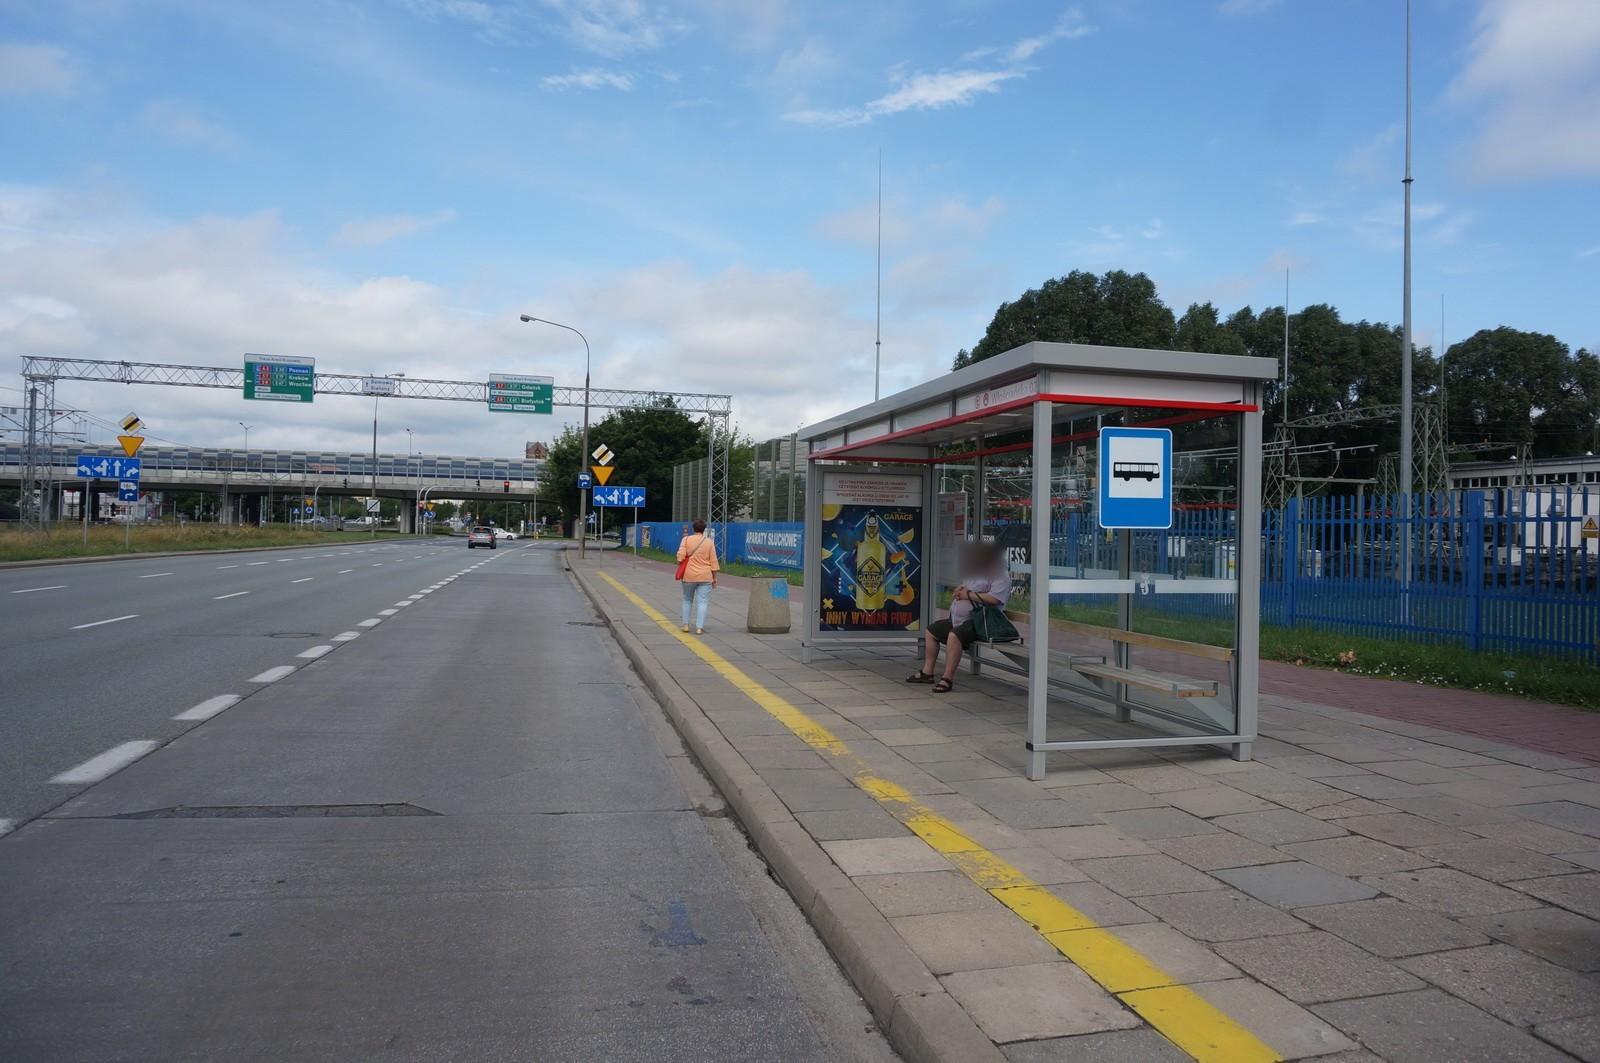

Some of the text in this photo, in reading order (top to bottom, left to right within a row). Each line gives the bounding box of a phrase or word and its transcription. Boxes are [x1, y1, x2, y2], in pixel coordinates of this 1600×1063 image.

[883, 513, 913, 521] GARAGE
[745, 531, 767, 545] APARATY
[825, 611, 848, 625] INNY
[890, 611, 913, 625] PIWA
